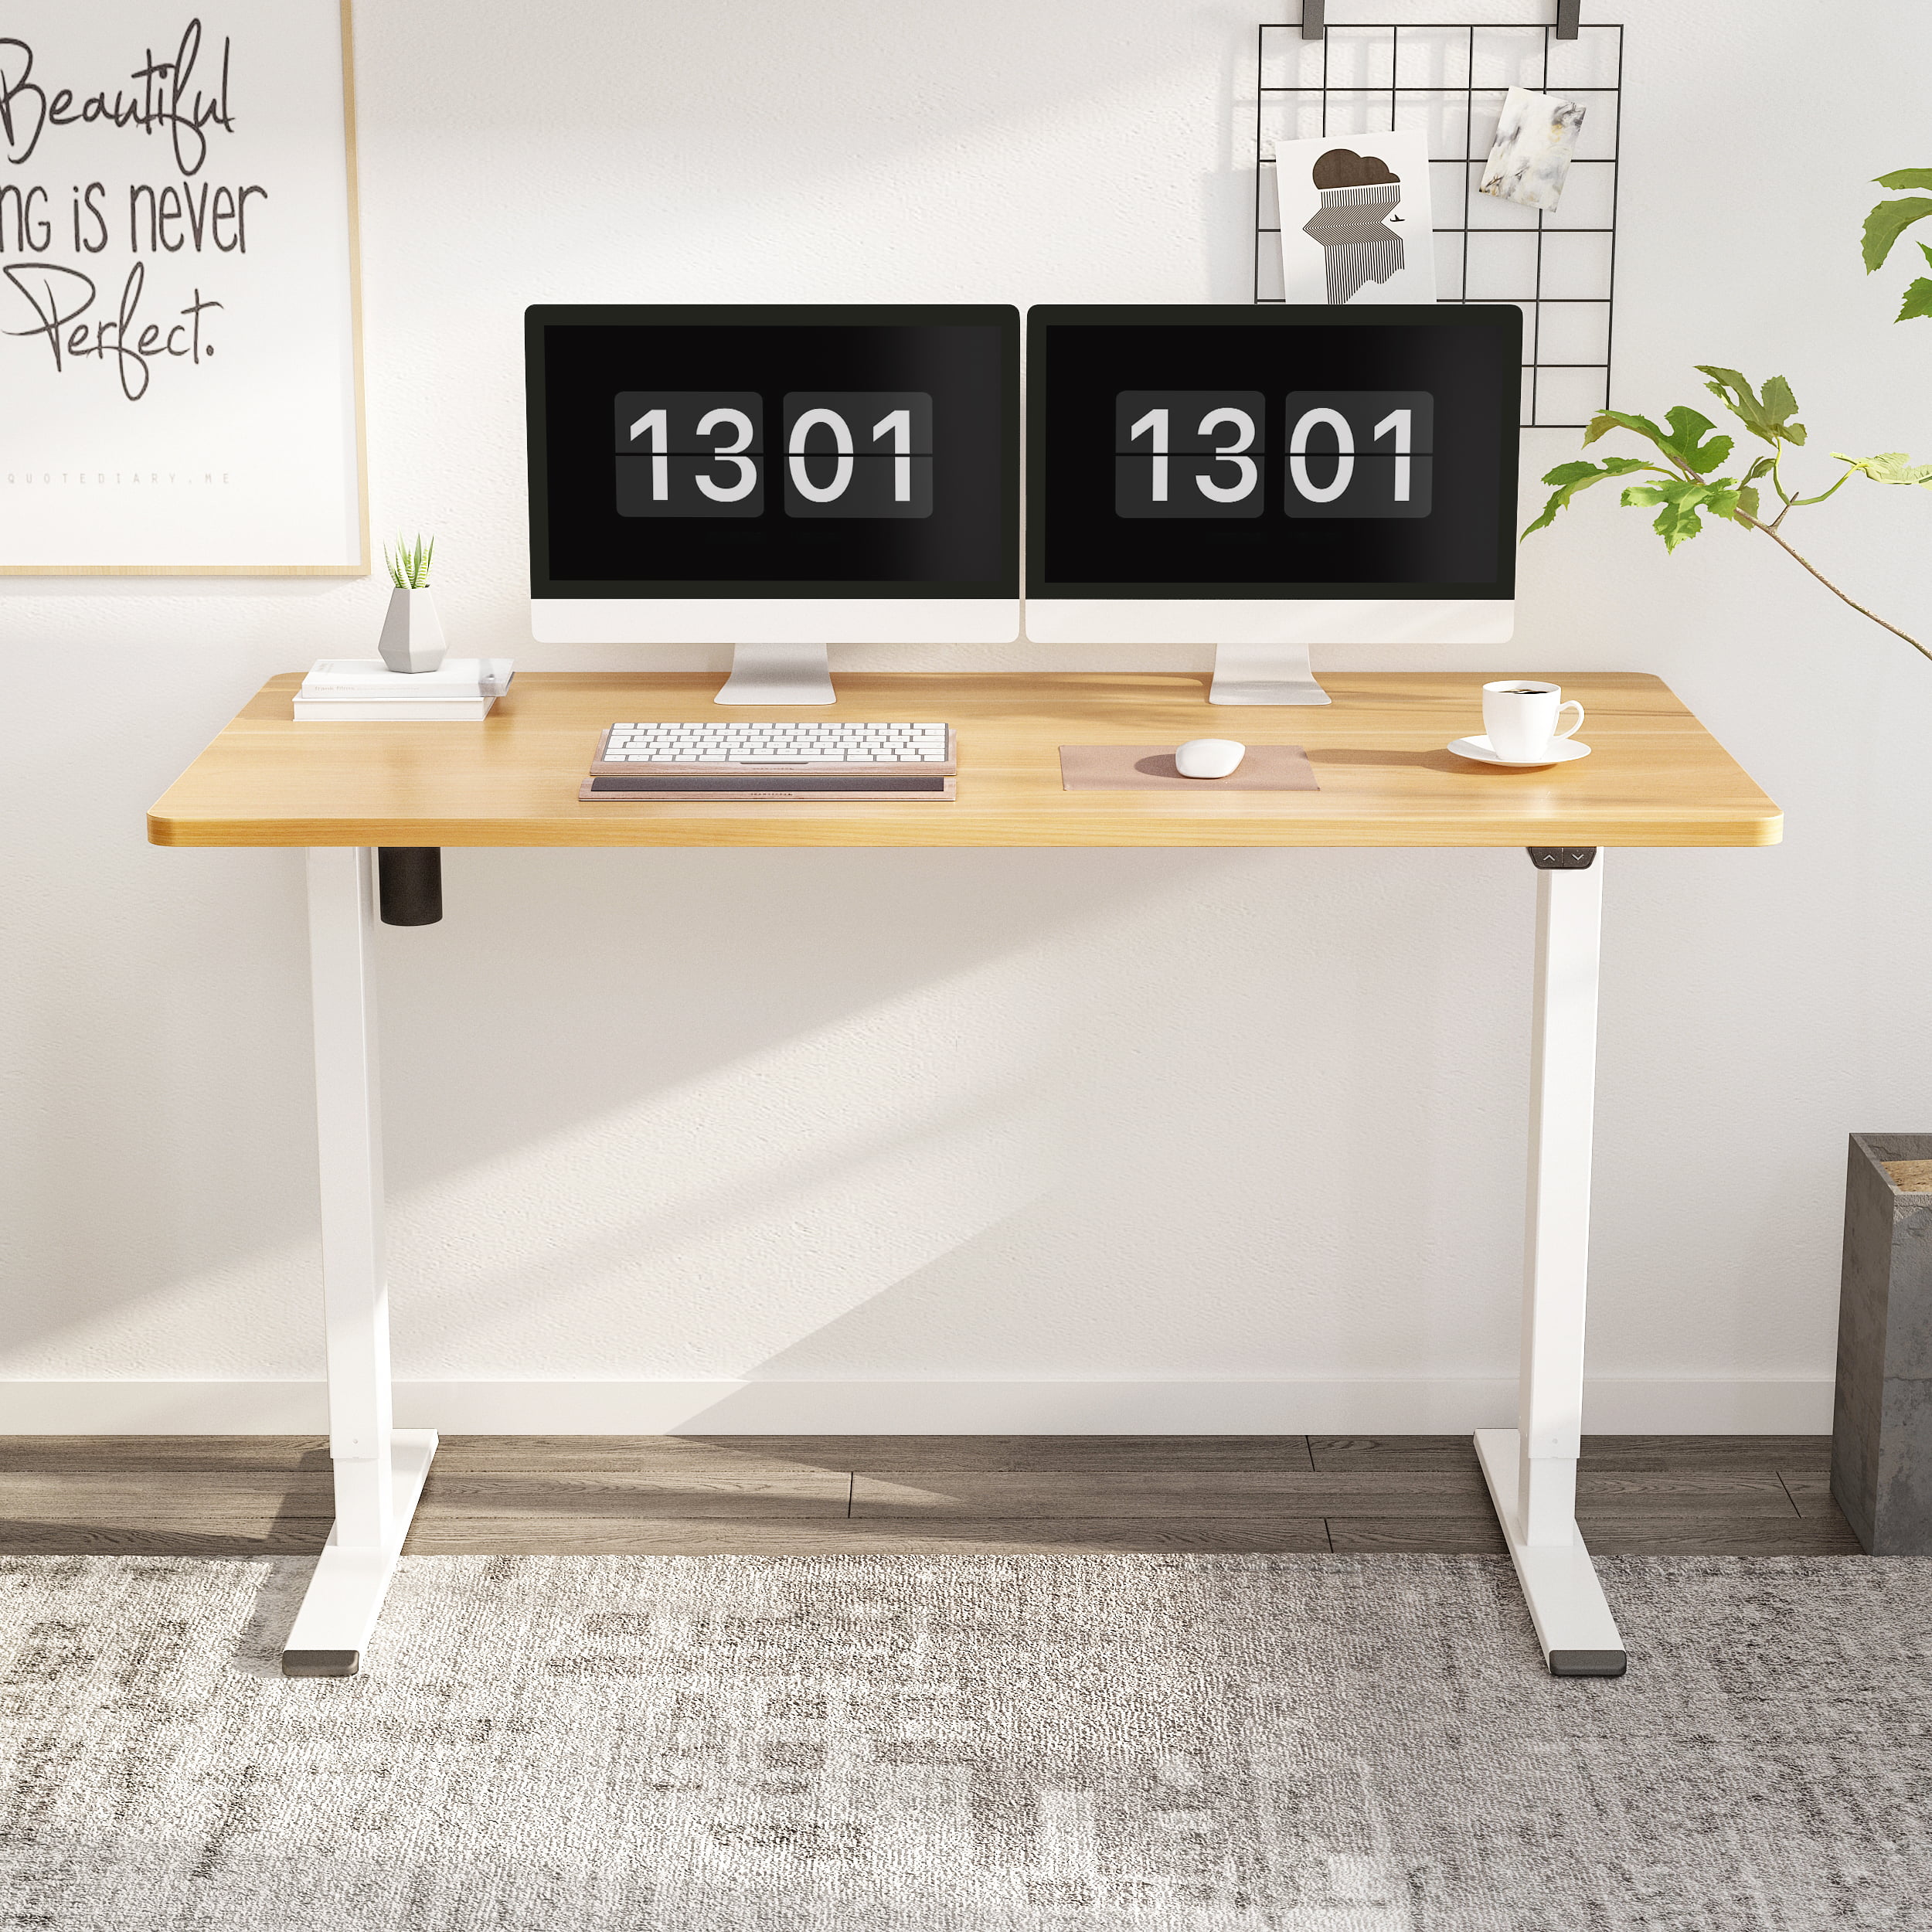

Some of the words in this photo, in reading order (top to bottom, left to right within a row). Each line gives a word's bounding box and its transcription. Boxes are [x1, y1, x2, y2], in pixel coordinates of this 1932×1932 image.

[0, 18, 236, 177] Beautiful
[130, 181, 268, 254] never
[1, 260, 224, 402] Perfect.
[630, 408, 757, 502] 13
[788, 408, 910, 503] 01
[1131, 407, 1258, 503] 13
[1290, 407, 1411, 503] 01
